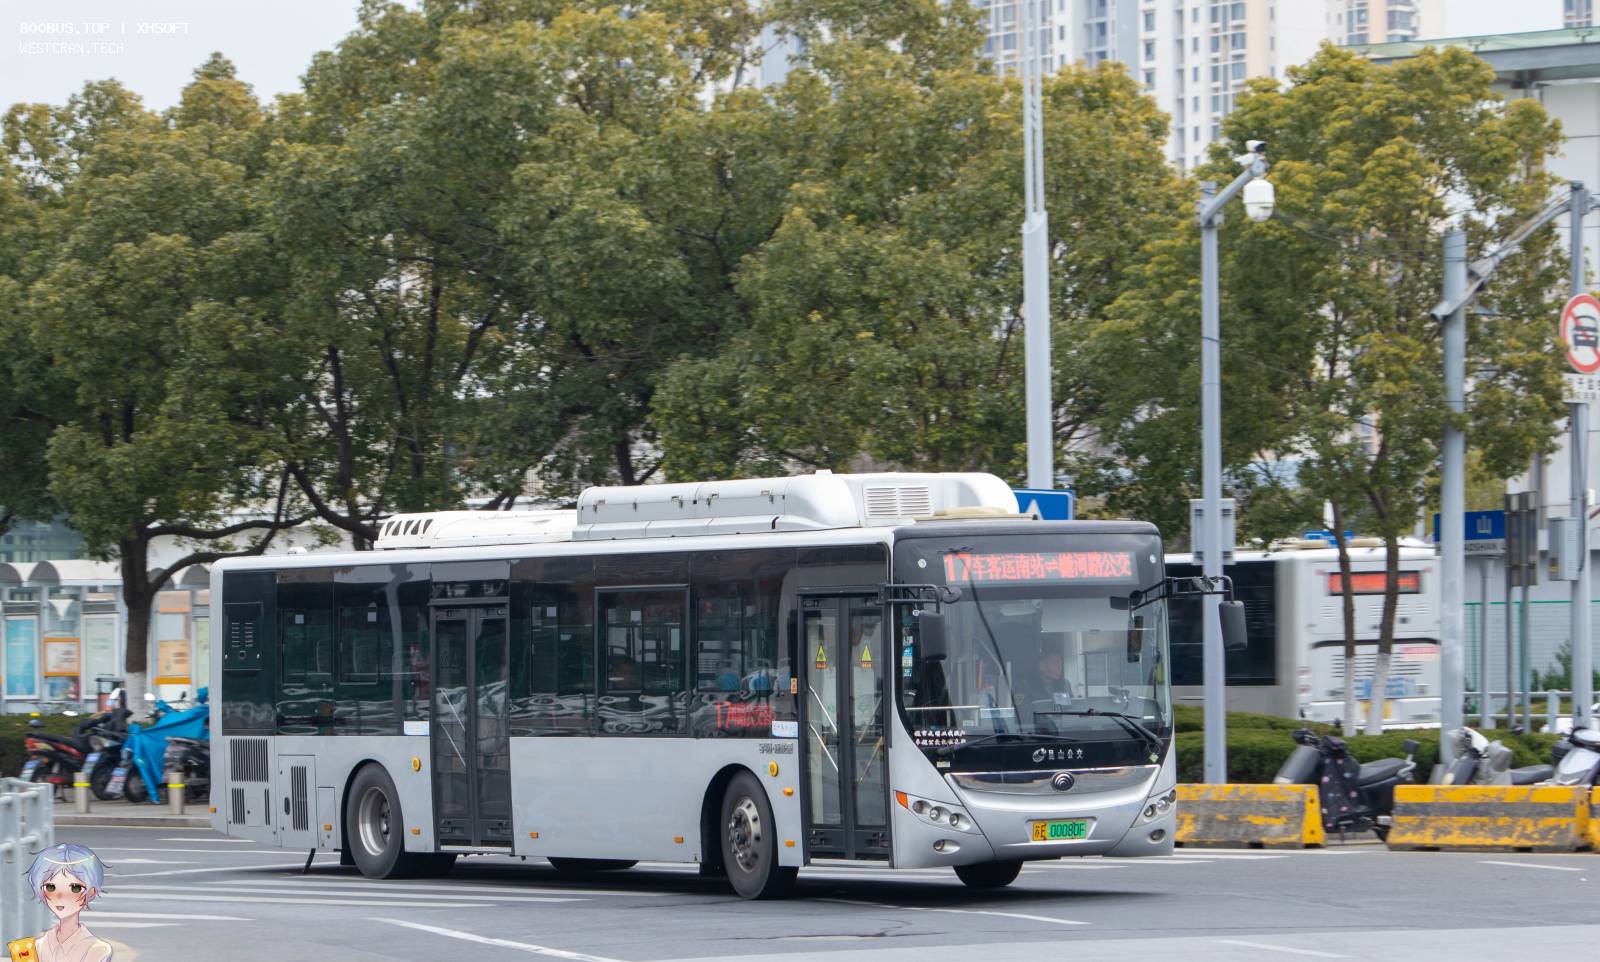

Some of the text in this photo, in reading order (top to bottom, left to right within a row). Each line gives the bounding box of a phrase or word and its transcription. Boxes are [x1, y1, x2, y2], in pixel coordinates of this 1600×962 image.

[945, 553, 971, 582] 17
[1048, 748, 1083, 760] 昆山公交
